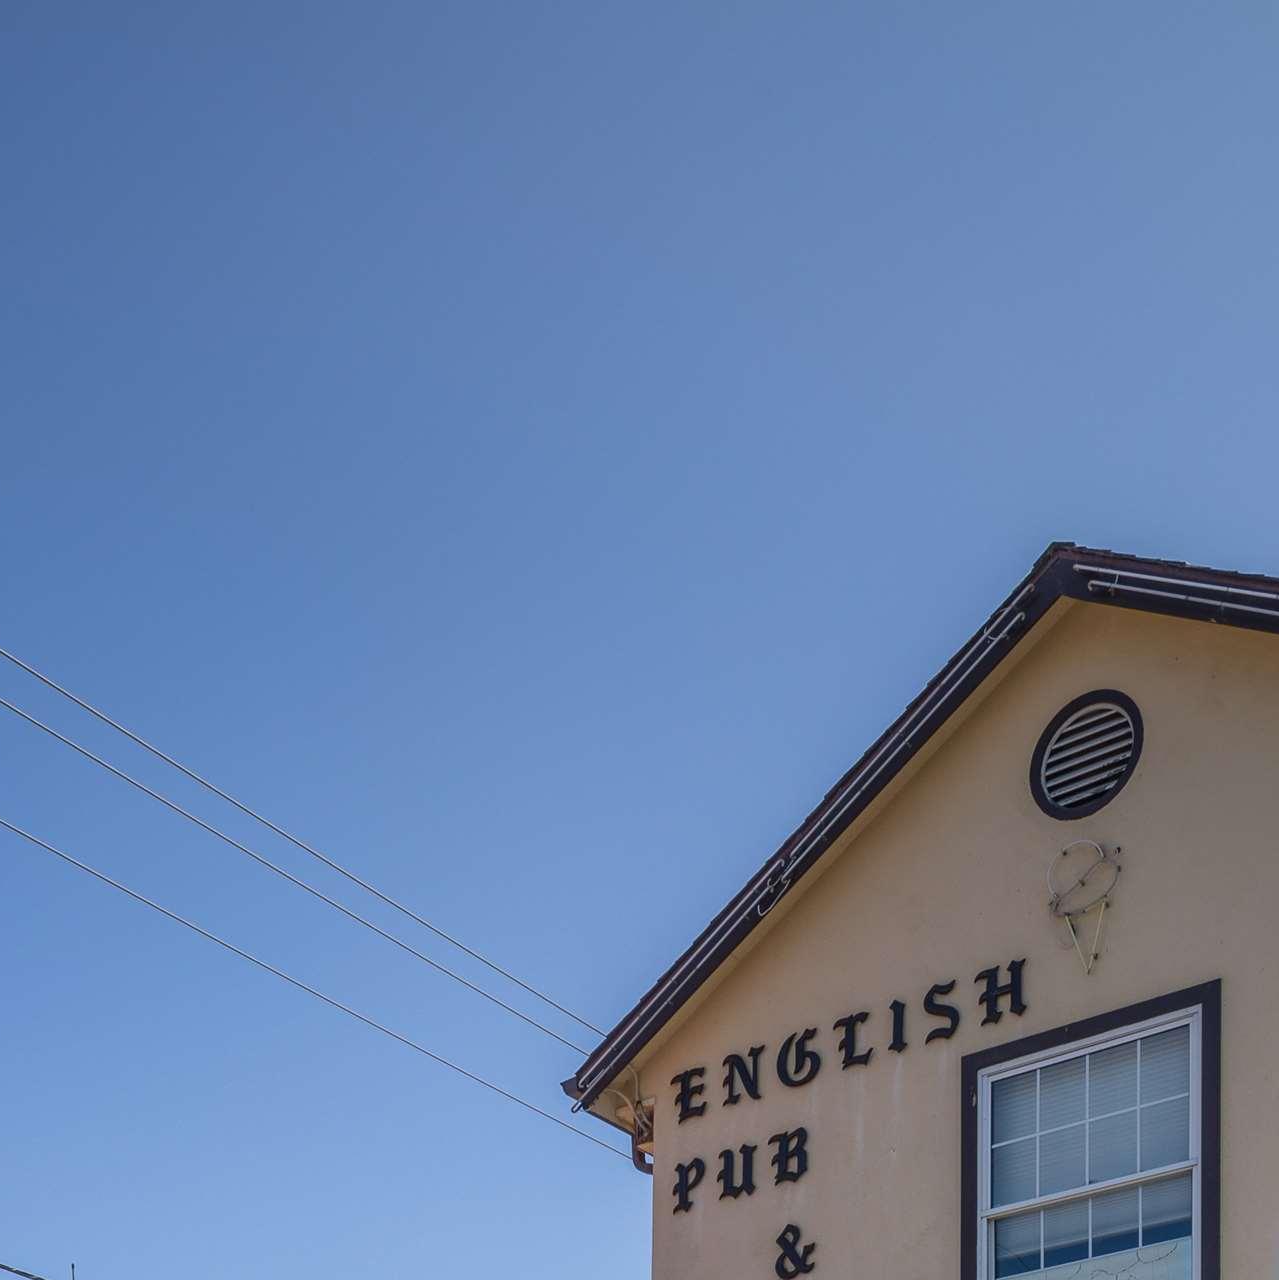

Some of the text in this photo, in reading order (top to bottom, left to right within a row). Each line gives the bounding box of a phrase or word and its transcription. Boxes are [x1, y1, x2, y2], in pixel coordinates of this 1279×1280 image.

[670, 958, 1028, 1126] ENGLISH
[672, 1126, 809, 1215] PUB
[774, 1223, 816, 1280] &
